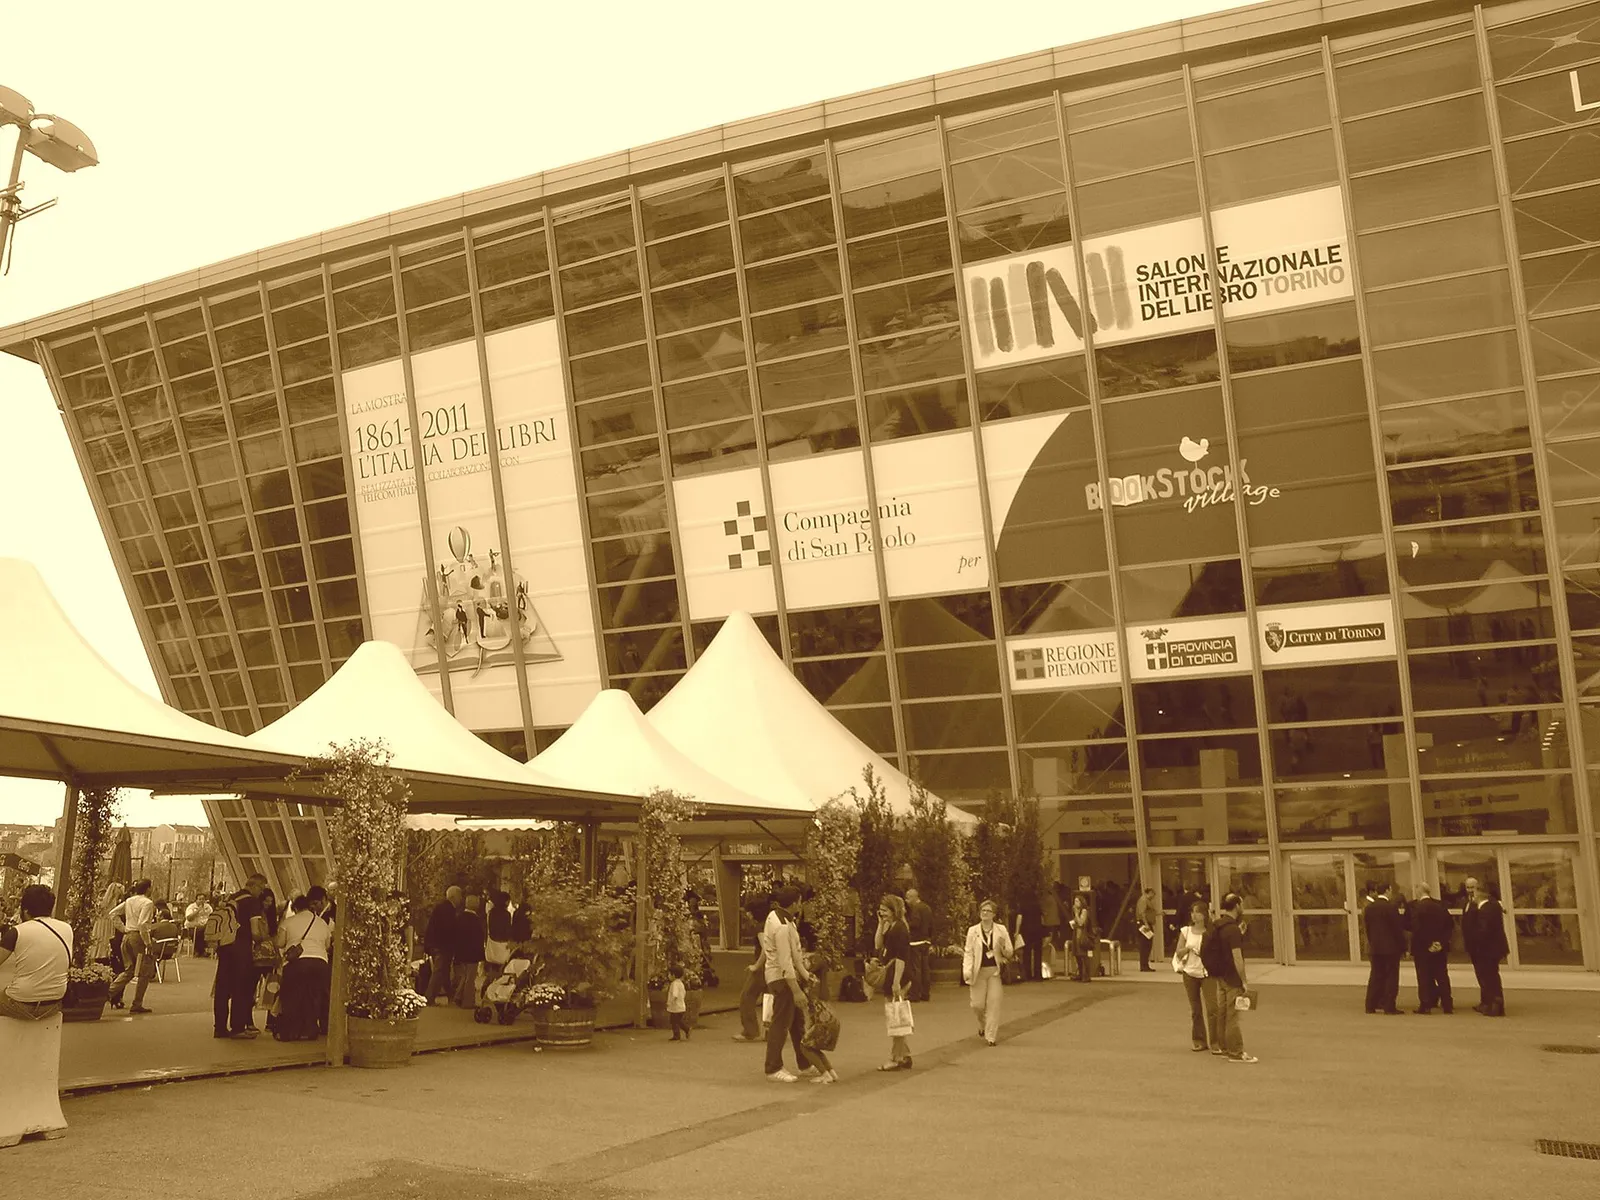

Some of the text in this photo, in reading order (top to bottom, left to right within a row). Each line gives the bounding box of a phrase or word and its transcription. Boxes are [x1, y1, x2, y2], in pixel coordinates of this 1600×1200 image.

[1136, 246, 1230, 282] SALONE
[1139, 244, 1343, 302] INTERNAZIONALE
[1141, 266, 1345, 321] DEL LIBRO TORINO
[351, 392, 407, 415] LA MOSTRA
[451, 432, 487, 461] DEI
[497, 418, 557, 451] LIBRI
[783, 497, 912, 534] Compagnia
[788, 525, 916, 562] di San Paolo
[957, 555, 982, 574] per
[1046, 642, 1117, 663] REGIONE
[1170, 640, 1233, 654] PROVINCIA
[1170, 651, 1234, 667] DI TORINO
[1047, 659, 1118, 678] PIEMONTE
